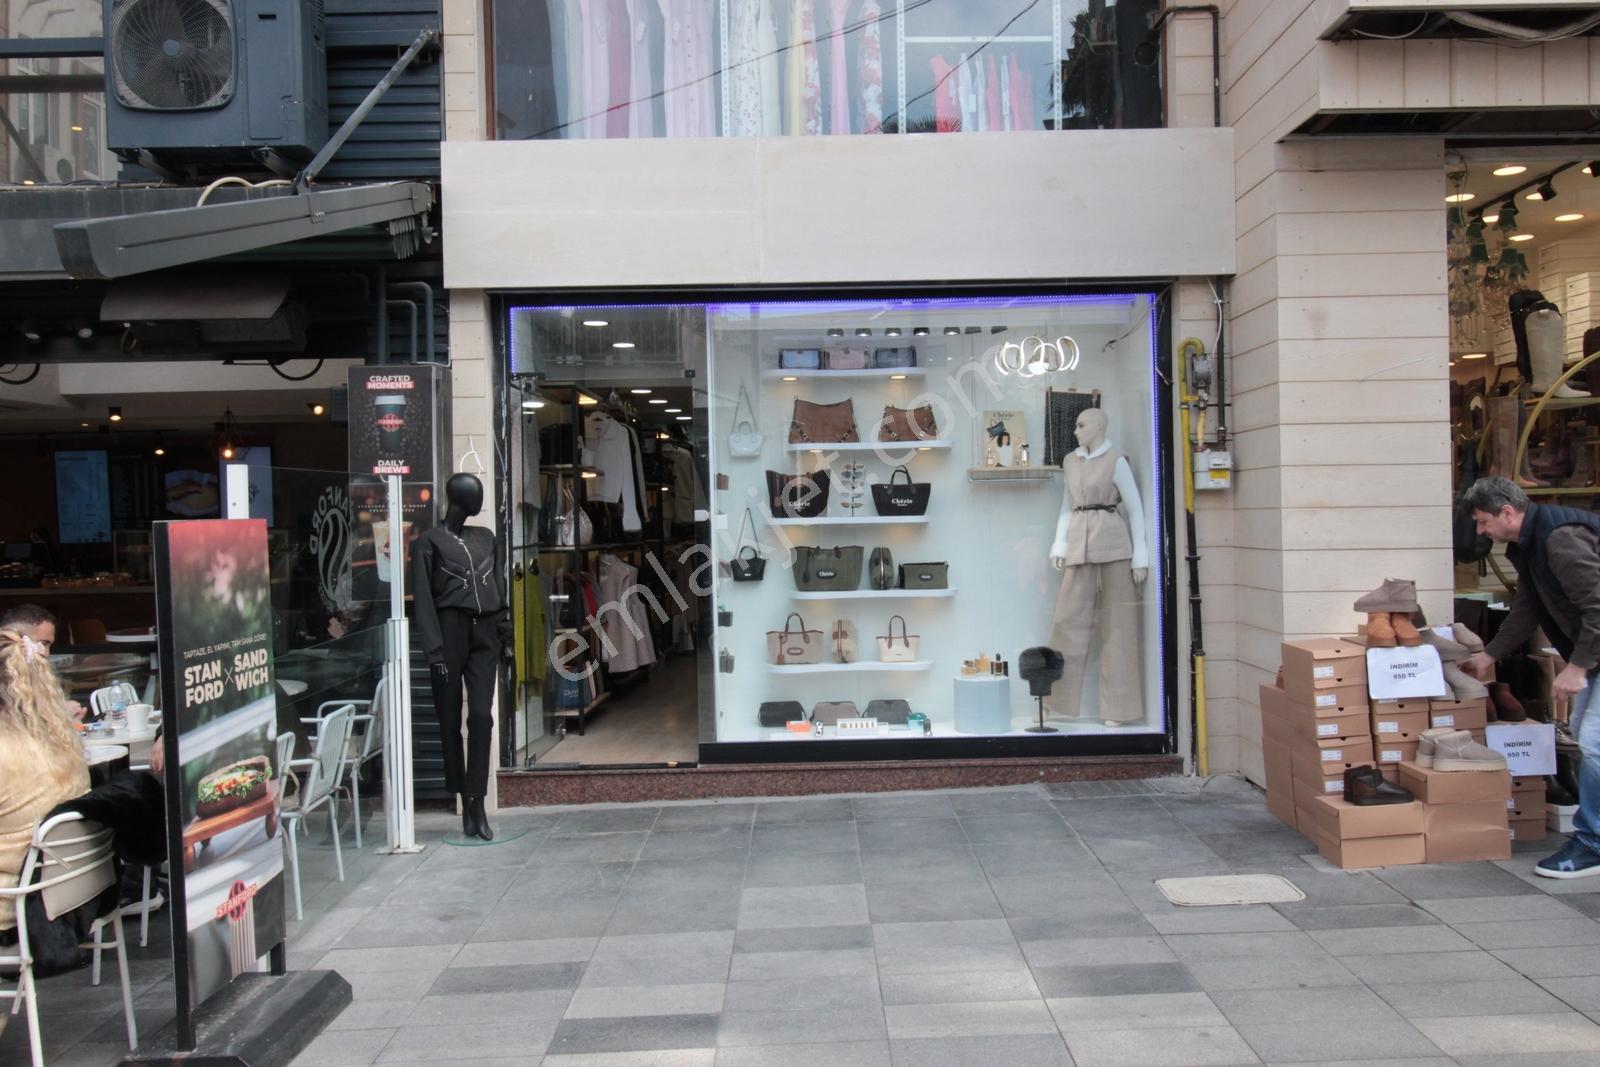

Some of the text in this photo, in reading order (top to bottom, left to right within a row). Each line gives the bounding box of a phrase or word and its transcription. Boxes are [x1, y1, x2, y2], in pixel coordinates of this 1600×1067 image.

[367, 381, 414, 389] MOMENTS
[373, 466, 410, 474] BREWS
[184, 660, 222, 687] STAN
[234, 648, 268, 673] SAND
[1390, 661, 1419, 670] İNDİRİM
[185, 666, 269, 708] FORD WICH
[1503, 740, 1532, 748] İNDİRİM
[216, 883, 257, 918] STANFORD
